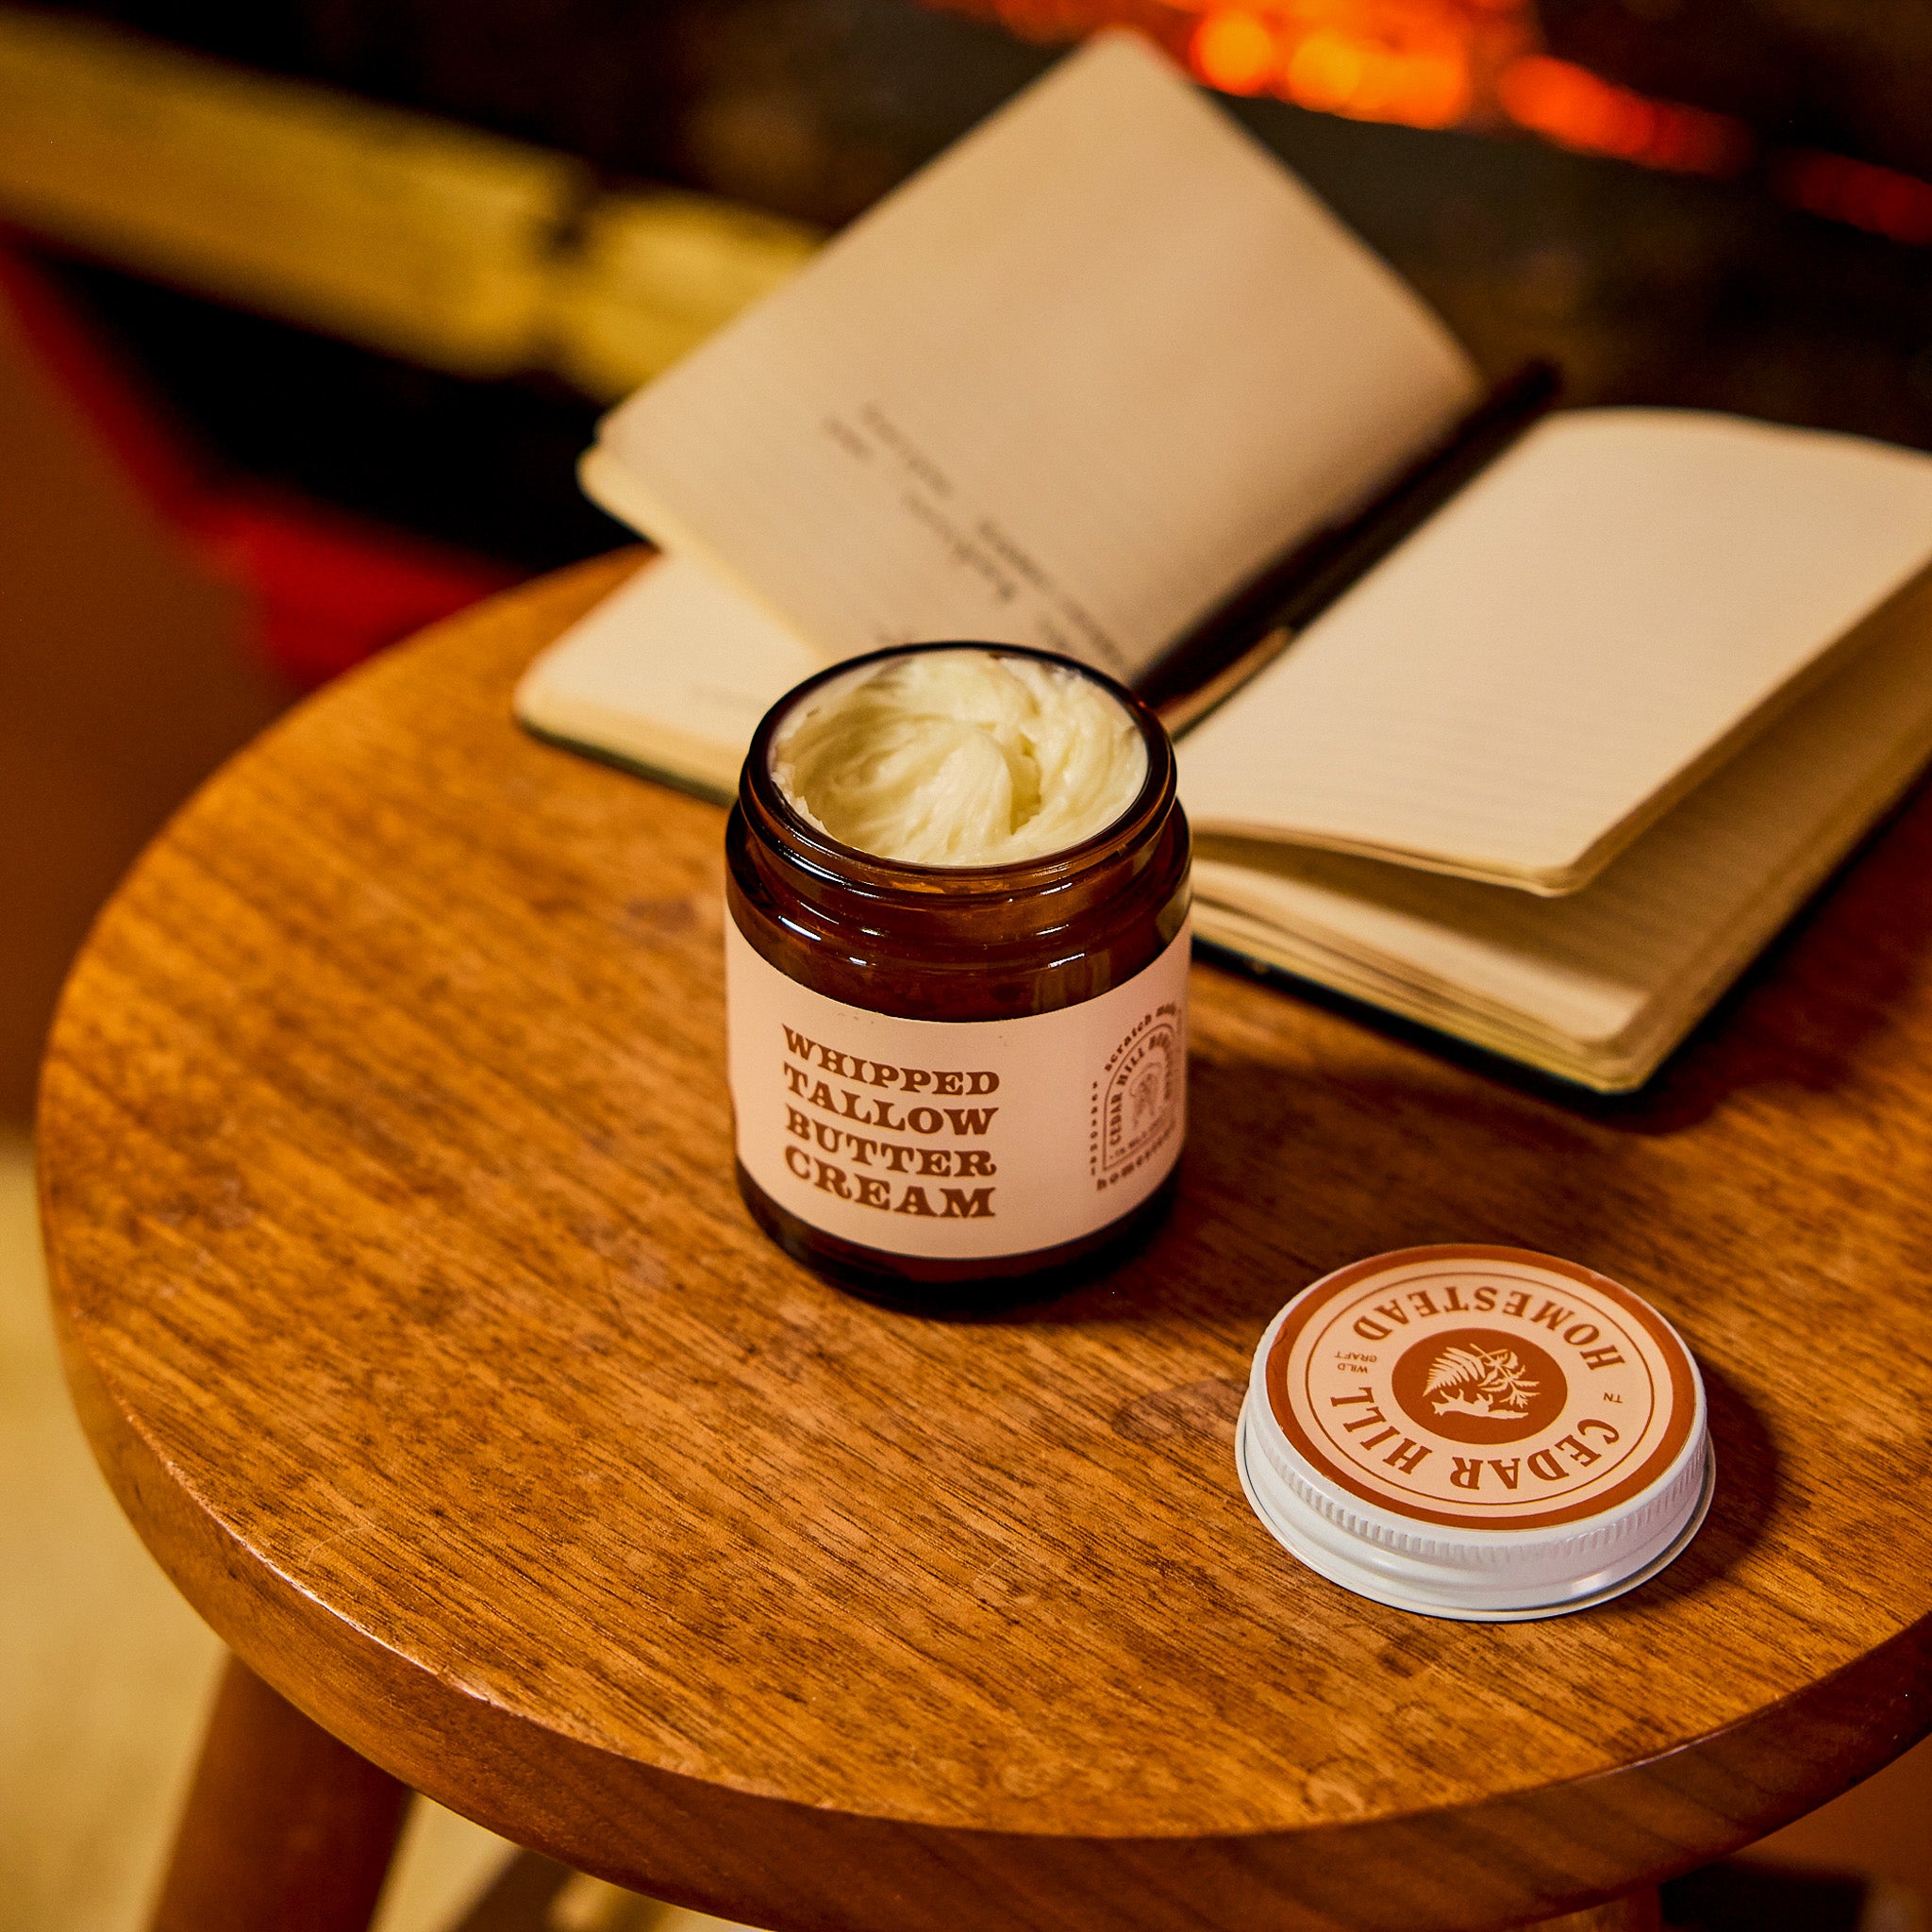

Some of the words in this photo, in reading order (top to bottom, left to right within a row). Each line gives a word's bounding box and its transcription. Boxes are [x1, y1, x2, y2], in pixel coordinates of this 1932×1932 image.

[782, 1023, 1000, 1096] WHIPPED
[1104, 1013, 1153, 1074] scratch
[783, 1060, 999, 1136] TALLOW
[785, 1102, 997, 1178] BUTTER
[784, 1144, 996, 1219] CREAM
[1352, 1285, 1625, 1371] HOMESTEAD
[1337, 1362, 1368, 1374] WILD
[1603, 1391, 1624, 1404] TN
[1330, 1386, 1433, 1475] HILL
[1449, 1418, 1621, 1491] CEDAR
